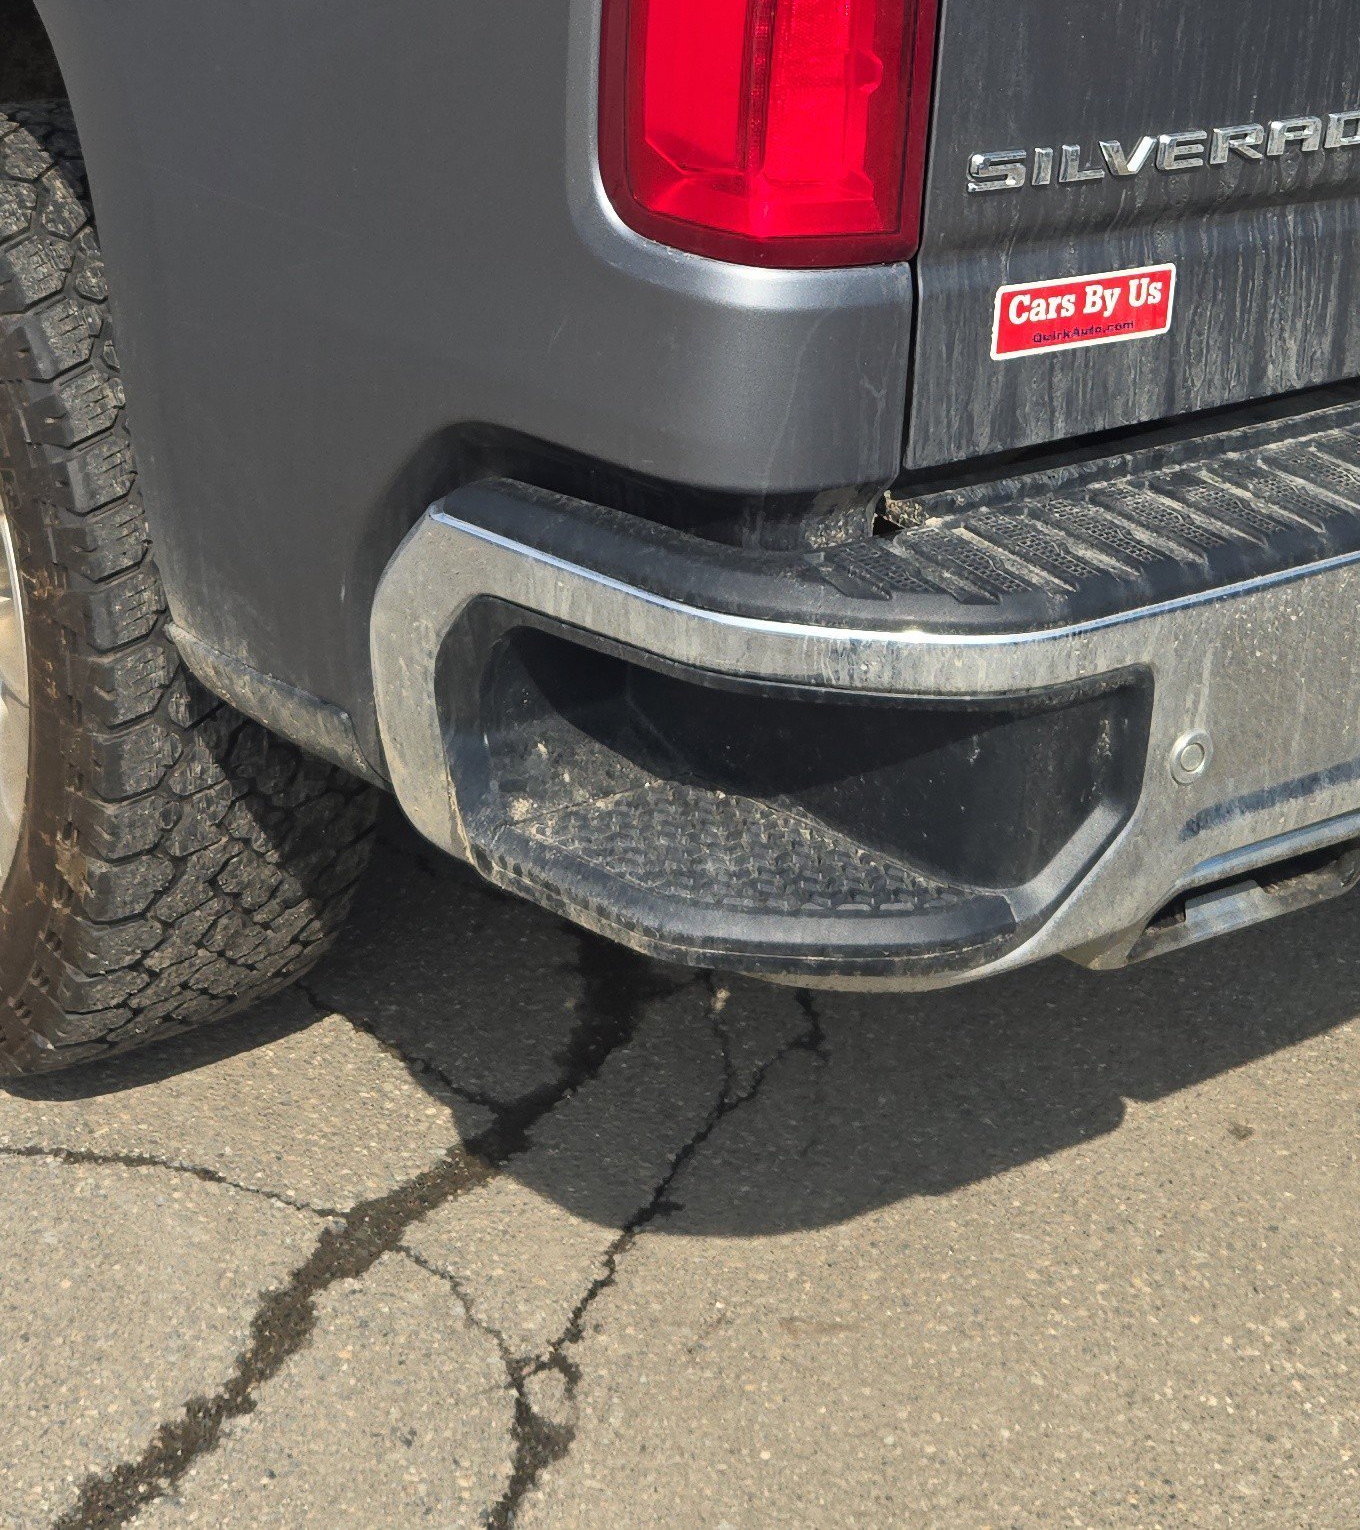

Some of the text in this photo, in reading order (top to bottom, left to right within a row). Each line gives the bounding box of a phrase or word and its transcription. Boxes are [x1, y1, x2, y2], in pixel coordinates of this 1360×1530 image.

[1008, 277, 1163, 325] Cars By Us
[1031, 320, 1134, 343] QuirkAuto.com
